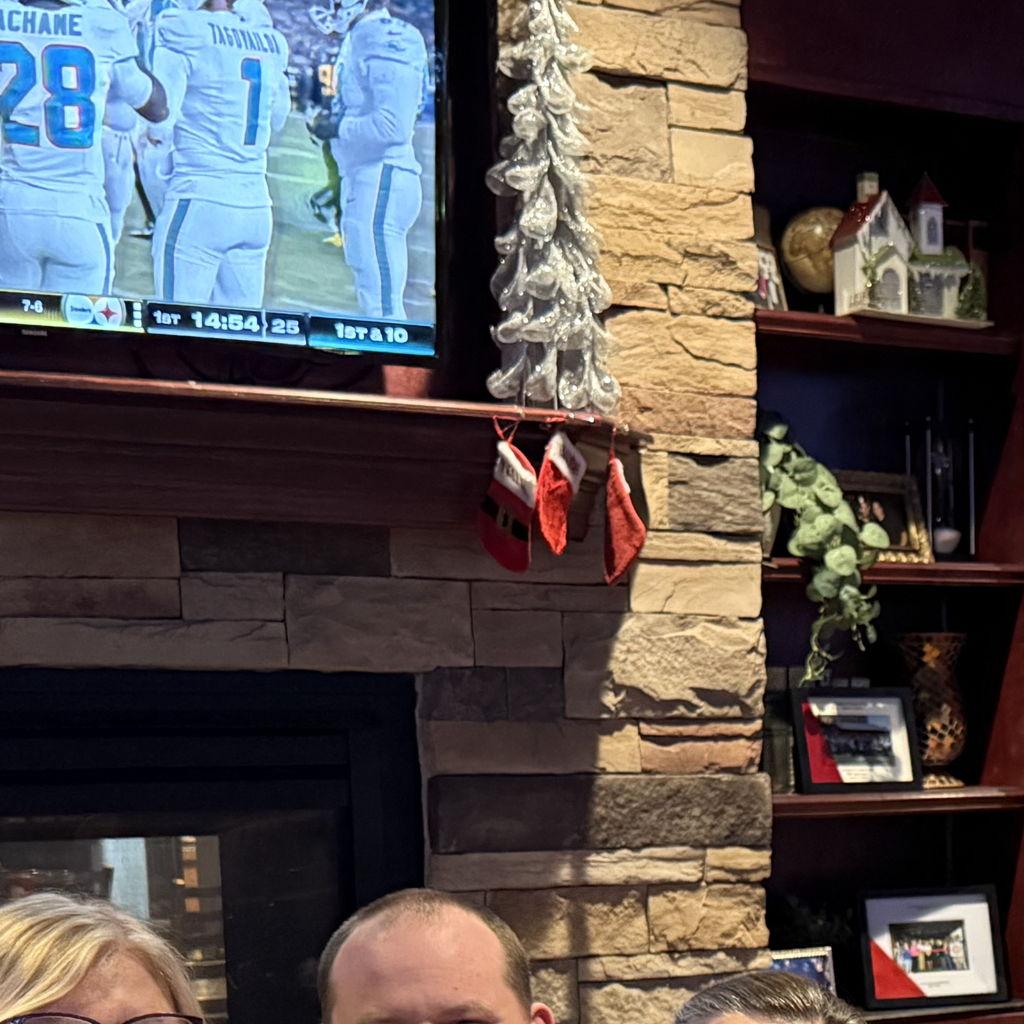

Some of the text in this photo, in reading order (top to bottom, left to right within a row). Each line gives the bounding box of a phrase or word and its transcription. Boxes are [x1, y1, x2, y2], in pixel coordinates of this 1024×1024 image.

[0, 41, 95, 149] 28
[241, 57, 262, 146] 1
[153, 310, 260, 333] 1ST 14:54
[271, 320, 300, 335] 25
[335, 323, 409, 344] 1ST & 10
